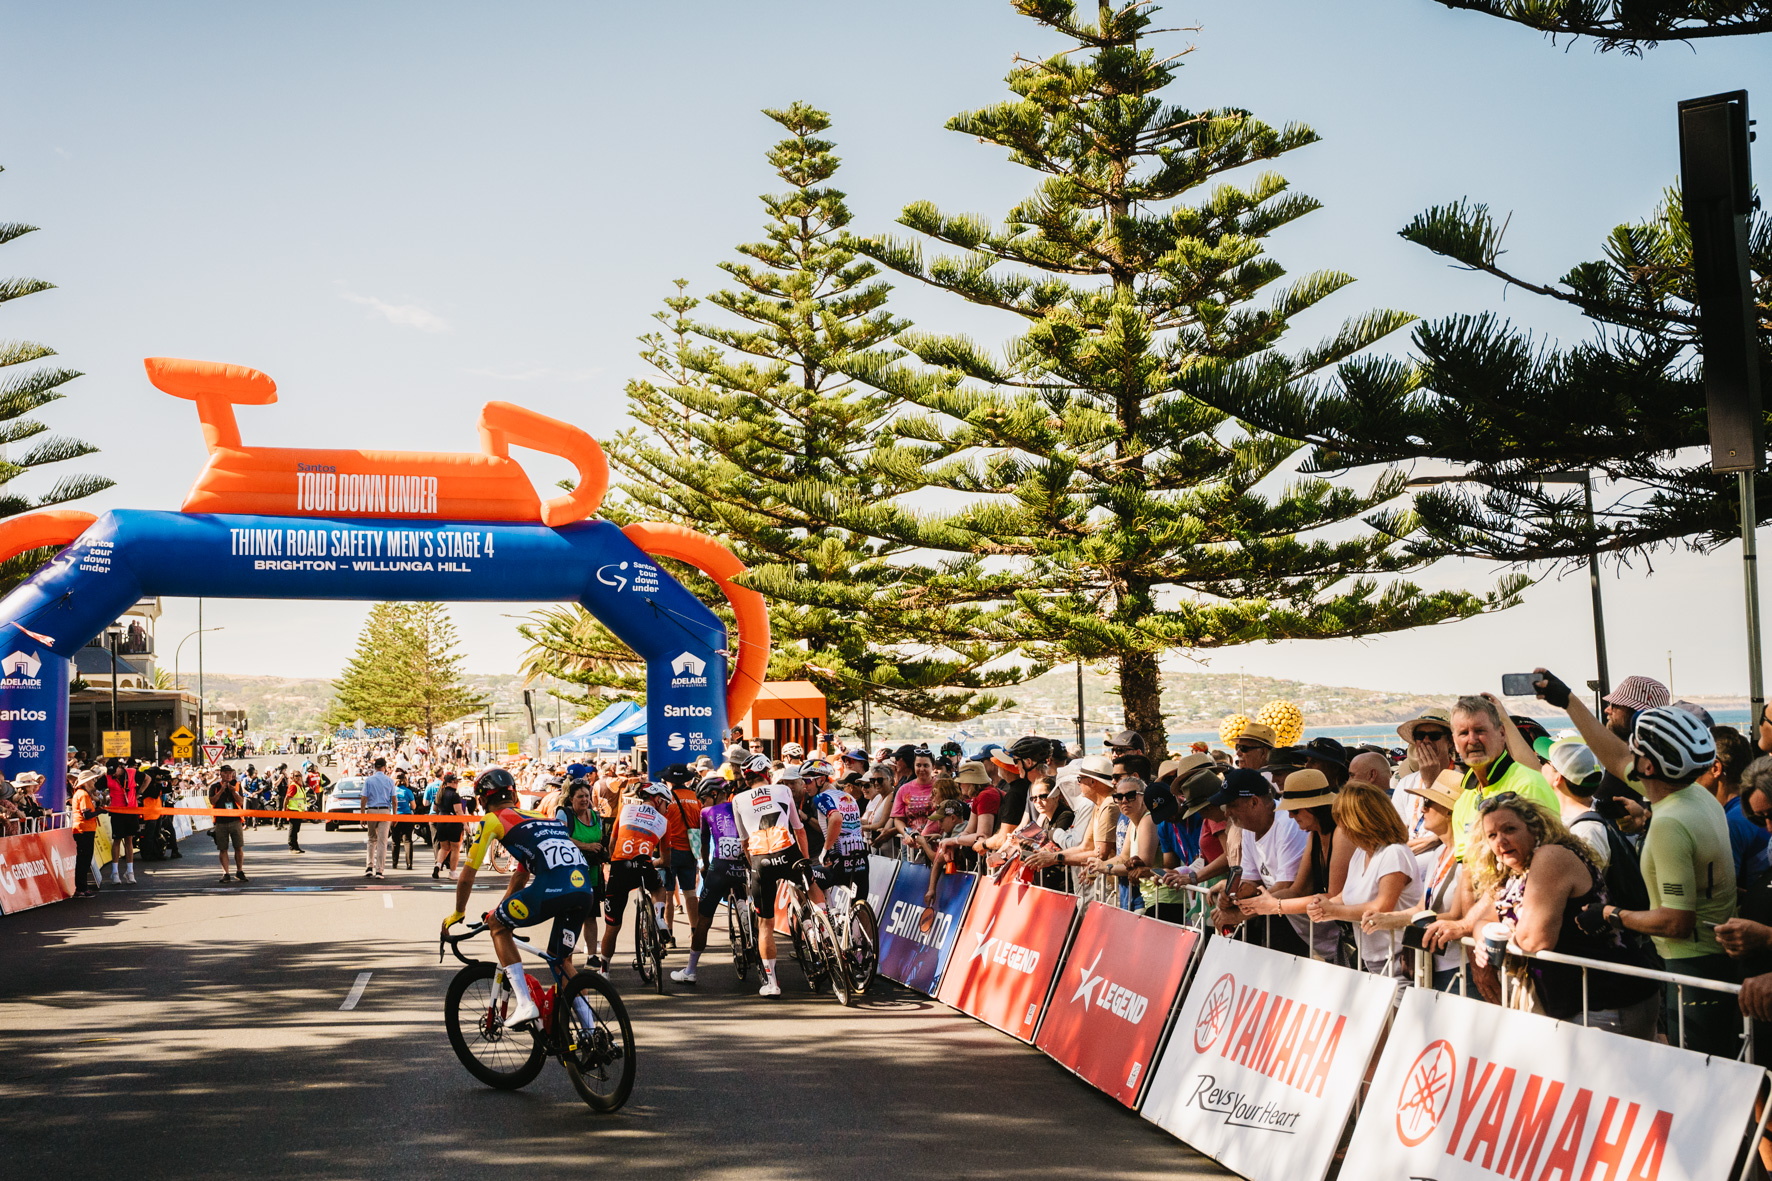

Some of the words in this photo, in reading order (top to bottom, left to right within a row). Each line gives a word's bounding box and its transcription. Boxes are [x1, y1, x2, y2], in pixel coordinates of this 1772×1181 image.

[297, 463, 336, 473] Santos
[297, 473, 336, 511] TOUR
[339, 474, 386, 513] DOWN
[388, 475, 438, 514] UNDER
[230, 528, 282, 556] THINK!
[287, 529, 327, 557] ROAD
[331, 530, 383, 557] SAFETY
[387, 531, 434, 558] MEN'S
[437, 532, 481, 558] STAGE
[484, 532, 495, 558] 4
[90, 548, 112, 556] tour
[83, 554, 111, 565] down
[254, 560, 336, 571] BRIGHTON
[352, 561, 434, 572] WILLUNGA
[438, 562, 471, 572] HILL
[80, 564, 111, 573] under
[639, 569, 658, 578] tour
[634, 576, 659, 585] down
[632, 584, 659, 592] under
[0, 678, 41, 686] ADELAIDE
[671, 677, 707, 685] ADELAIDE
[0, 708, 47, 721] antos
[664, 704, 712, 717] Santos
[751, 788, 771, 799] UAE
[622, 840, 635, 854] 6
[751, 836, 762, 850] 2
[771, 855, 788, 866] IHC
[11, 859, 48, 880] GATORADE
[885, 900, 953, 950] SHIMNO
[992, 939, 1041, 975] LEGEND
[1096, 979, 1149, 1025] LEGEND
[1220, 984, 1347, 1099] YAMAHA
[1186, 1075, 1236, 1114] Revs
[1223, 1093, 1264, 1125] Your
[1257, 1101, 1301, 1128] Heart
[1445, 1056, 1674, 1181] YAMAHA
